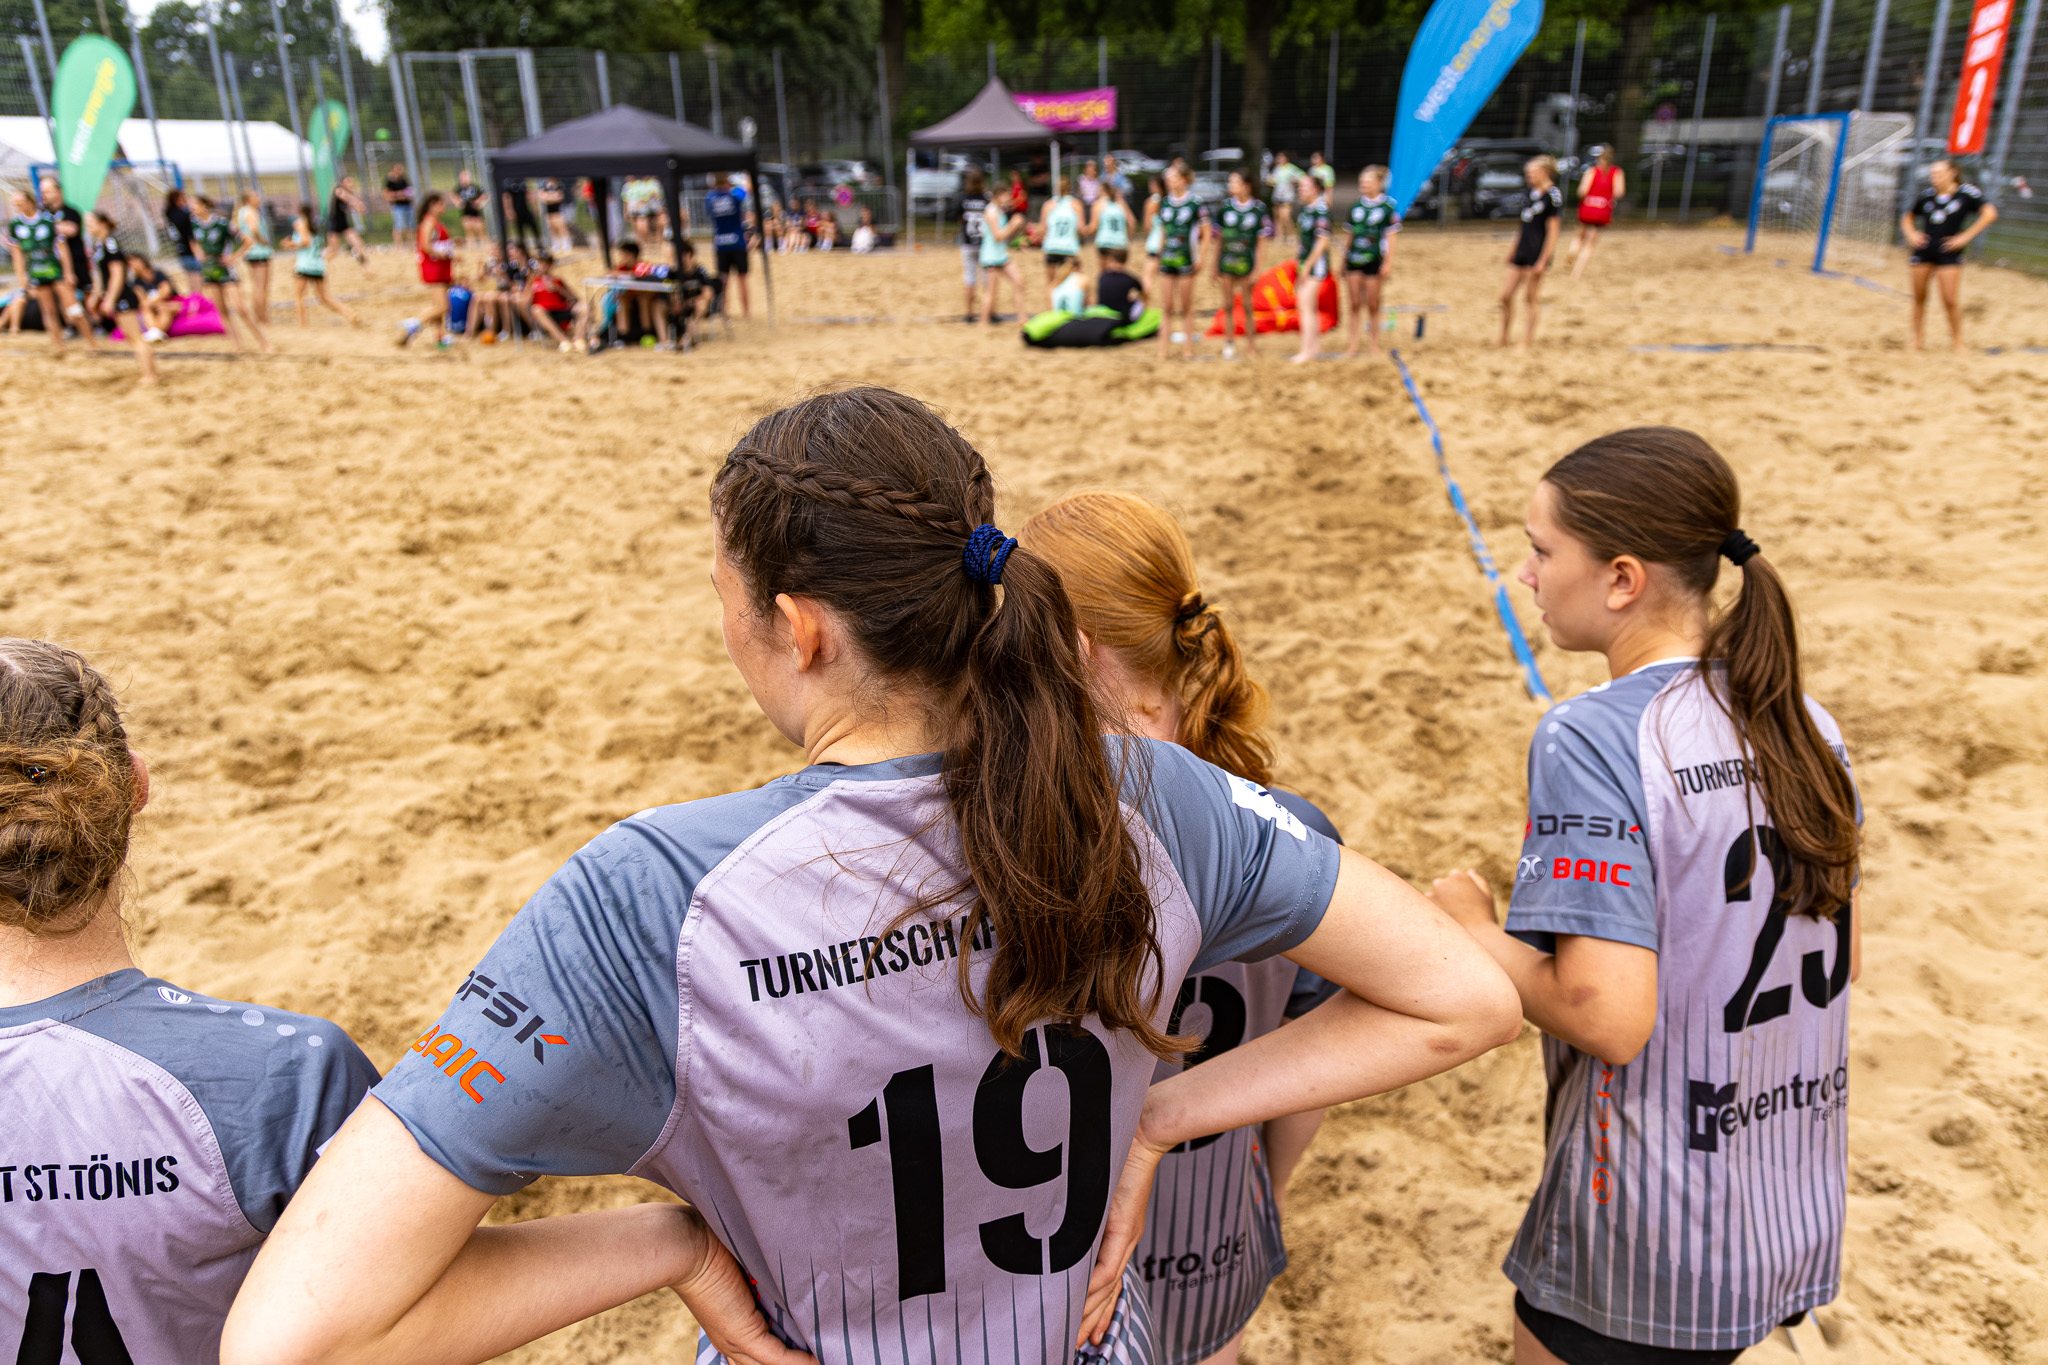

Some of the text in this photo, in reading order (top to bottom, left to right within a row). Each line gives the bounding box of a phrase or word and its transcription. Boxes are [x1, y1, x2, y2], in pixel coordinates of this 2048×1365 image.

[1537, 814, 1640, 845] DFSK
[1552, 857, 1633, 888] BAIC
[411, 1024, 506, 1104] BAIC
[848, 1022, 1112, 1303] 19
